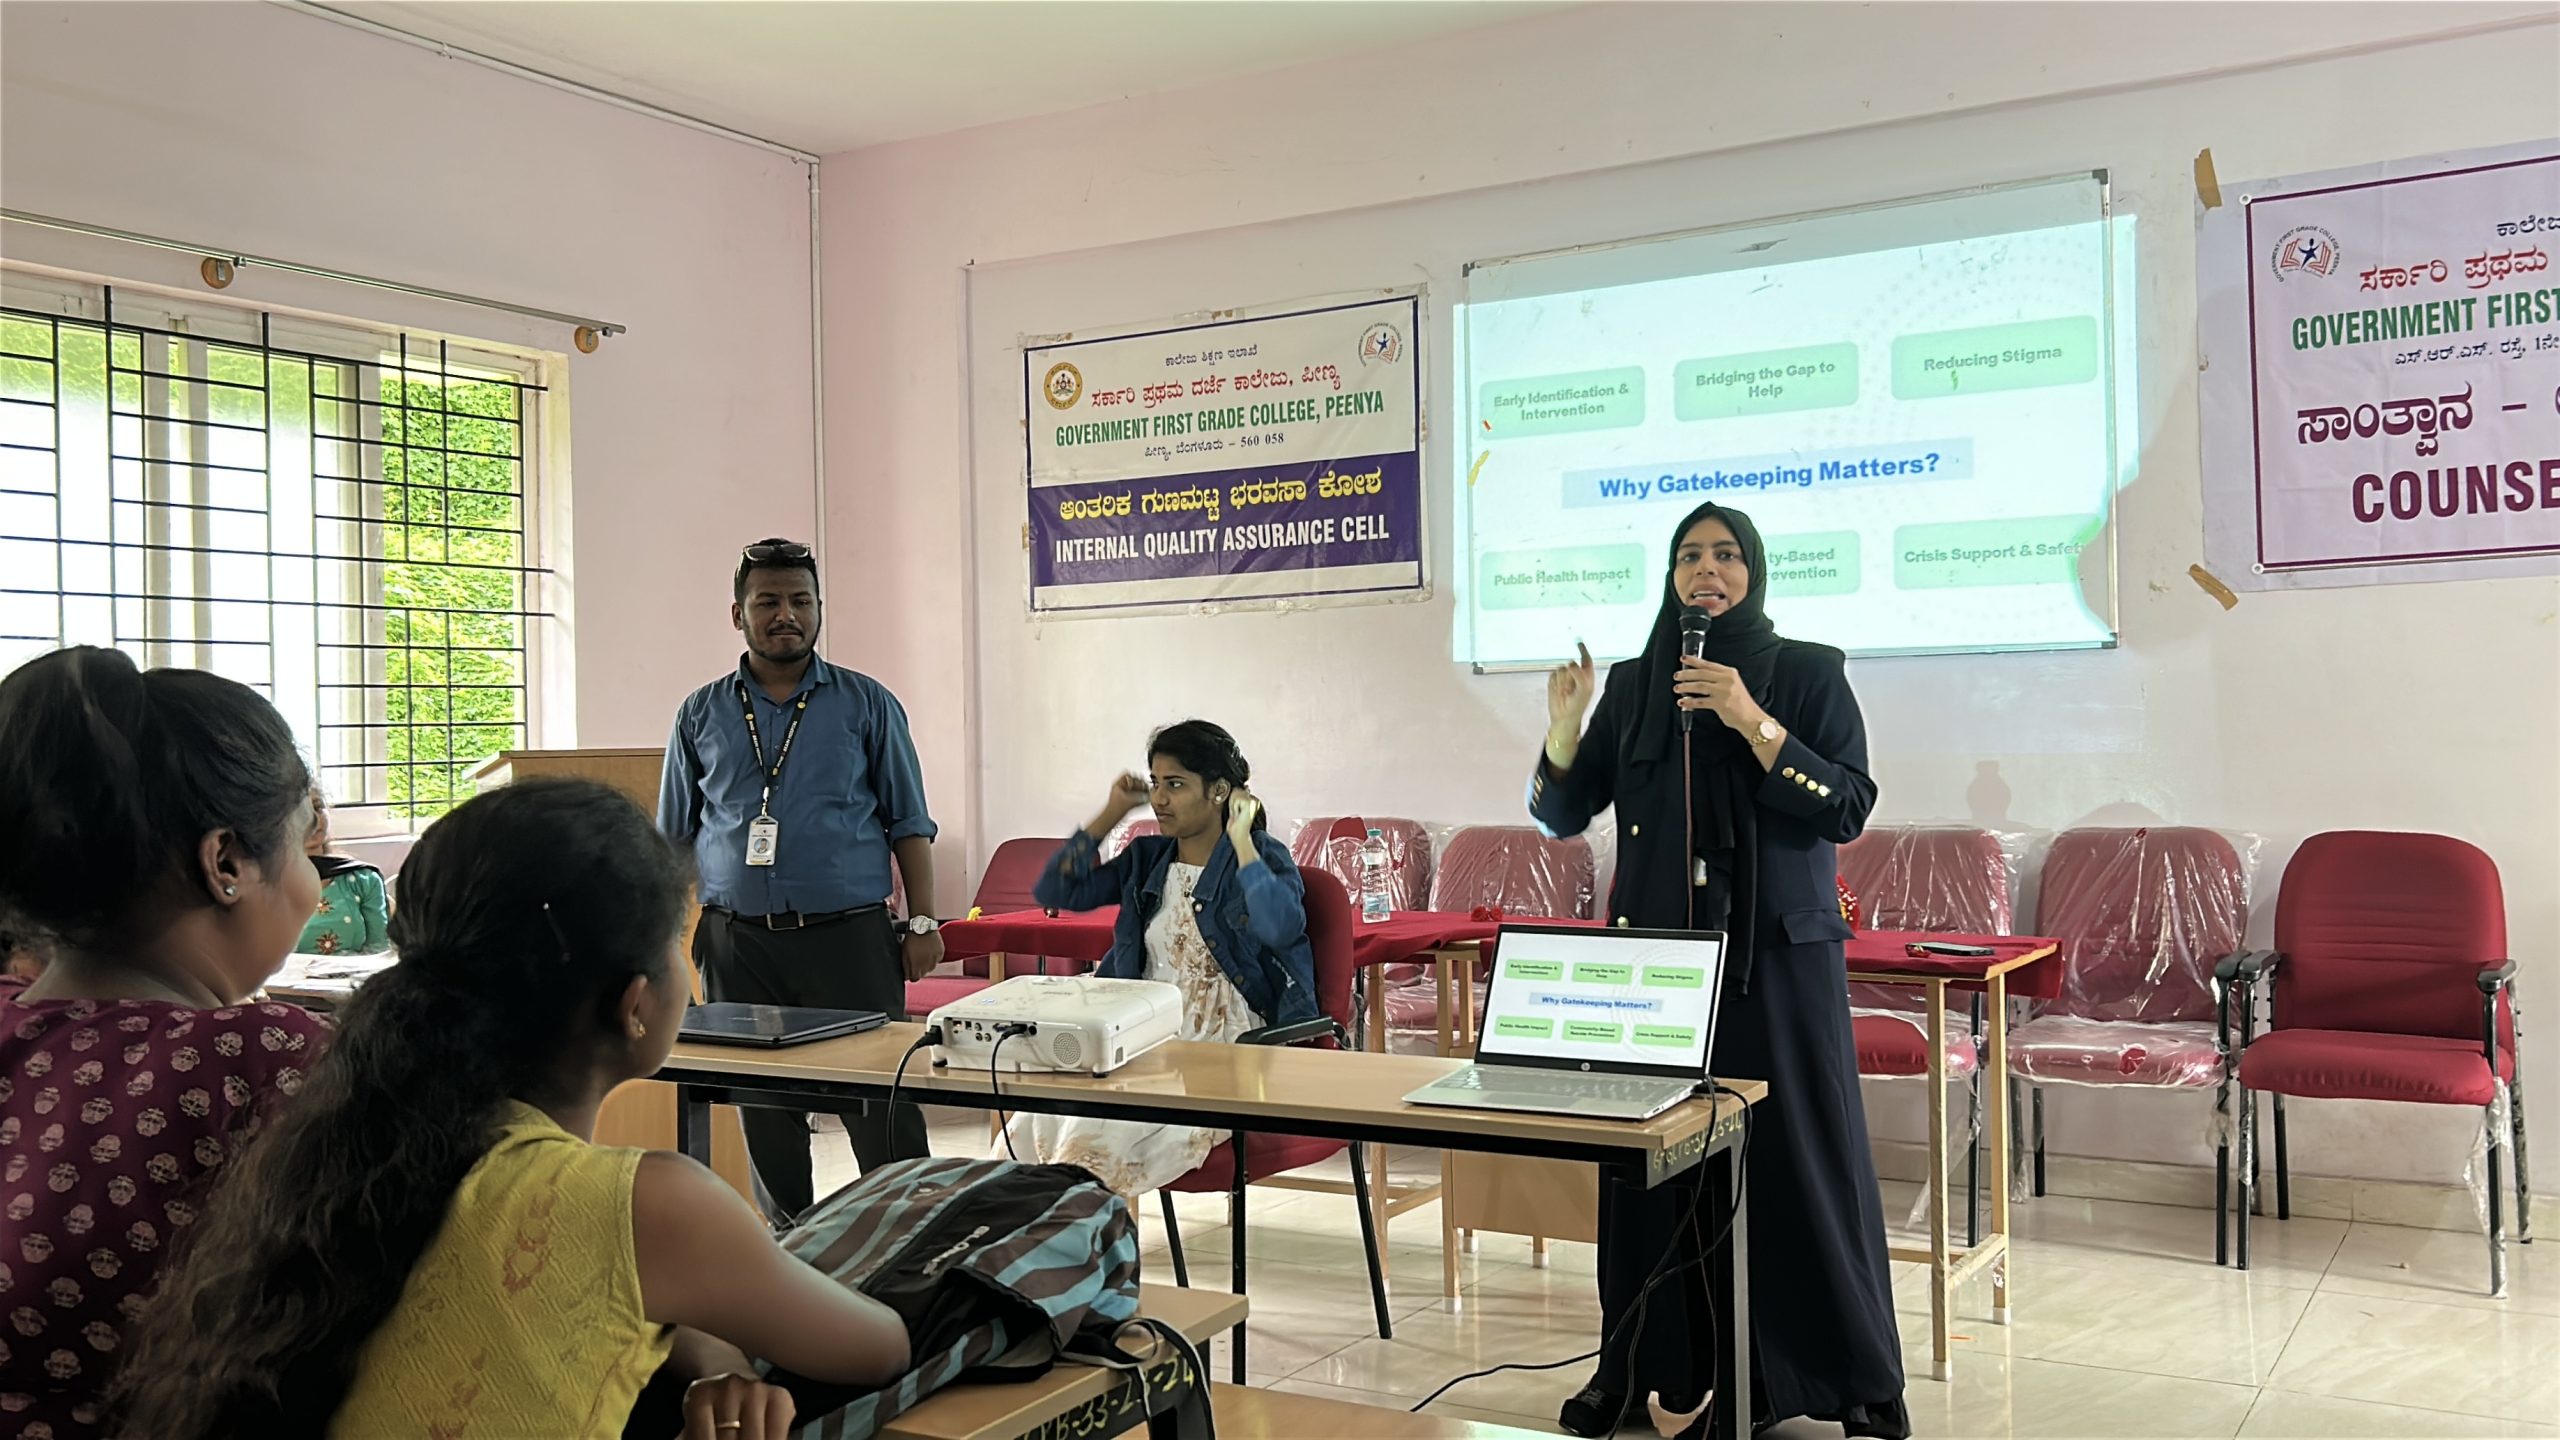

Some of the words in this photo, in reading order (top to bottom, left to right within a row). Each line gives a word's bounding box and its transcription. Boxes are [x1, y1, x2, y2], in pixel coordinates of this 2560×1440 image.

[2360, 259, 2449, 292] ಸರ್ಕಾರಿ
[2464, 244, 2549, 289] ಪ್ರಥಮ
[2292, 297, 2477, 351] GOVERNMENT
[2487, 288, 2560, 329] FIRST
[1924, 353, 1999, 371] Reducing
[2002, 347, 2063, 364] Stigma
[1696, 370, 1756, 386] Bridging
[1758, 367, 1783, 380] the
[1786, 364, 1816, 378] Gap
[1819, 361, 1836, 373] to
[1091, 386, 1136, 408] ಸರ್ಕಾರಿ
[1143, 379, 1184, 408] ಪ್ರಥಮ
[1192, 374, 1226, 396] ದರ್ಜೆ
[1493, 393, 1526, 408] Early
[1528, 384, 1615, 405] Identification
[1618, 383, 1630, 395] &
[1748, 384, 1784, 398] Help
[1056, 416, 1149, 447] GOVERNMENT
[1153, 412, 1194, 437] FIRST
[1198, 406, 1246, 432] GRADE
[1249, 398, 1321, 427] COLLEGE,
[1325, 390, 1384, 418] PEENYA
[1520, 403, 1605, 421] Intervention
[1240, 435, 1260, 448] 560
[1265, 432, 1285, 445] 058
[1599, 479, 1652, 500] Why
[1657, 466, 1813, 494] Gatekeeping
[1818, 452, 1940, 481] Matters?
[1141, 484, 1220, 522] ಗುಣಮಟ್ಟ
[1230, 476, 1307, 510] ಭರವಸಾ
[1318, 466, 1382, 498] ಕೋಶ
[2352, 458, 2560, 523] COUNSE
[1056, 535, 1139, 563] INTERNAL
[1143, 528, 1218, 559] QUALITY
[1222, 518, 1335, 551] ASSURANCE
[1341, 514, 1390, 543] CELL
[1768, 547, 1835, 566] ty-Based
[1904, 548, 1948, 562] Crisis
[1951, 545, 2016, 562] Support
[2019, 544, 2032, 556] &
[1494, 573, 1533, 586] Public
[1536, 570, 1579, 583] Health
[1581, 567, 1631, 584] Impact
[1766, 566, 1837, 580] evention
[1542, 997, 1560, 1005] Why
[1561, 997, 1612, 1008] Gatekeeping
[1614, 1001, 1653, 1010] Matters?
